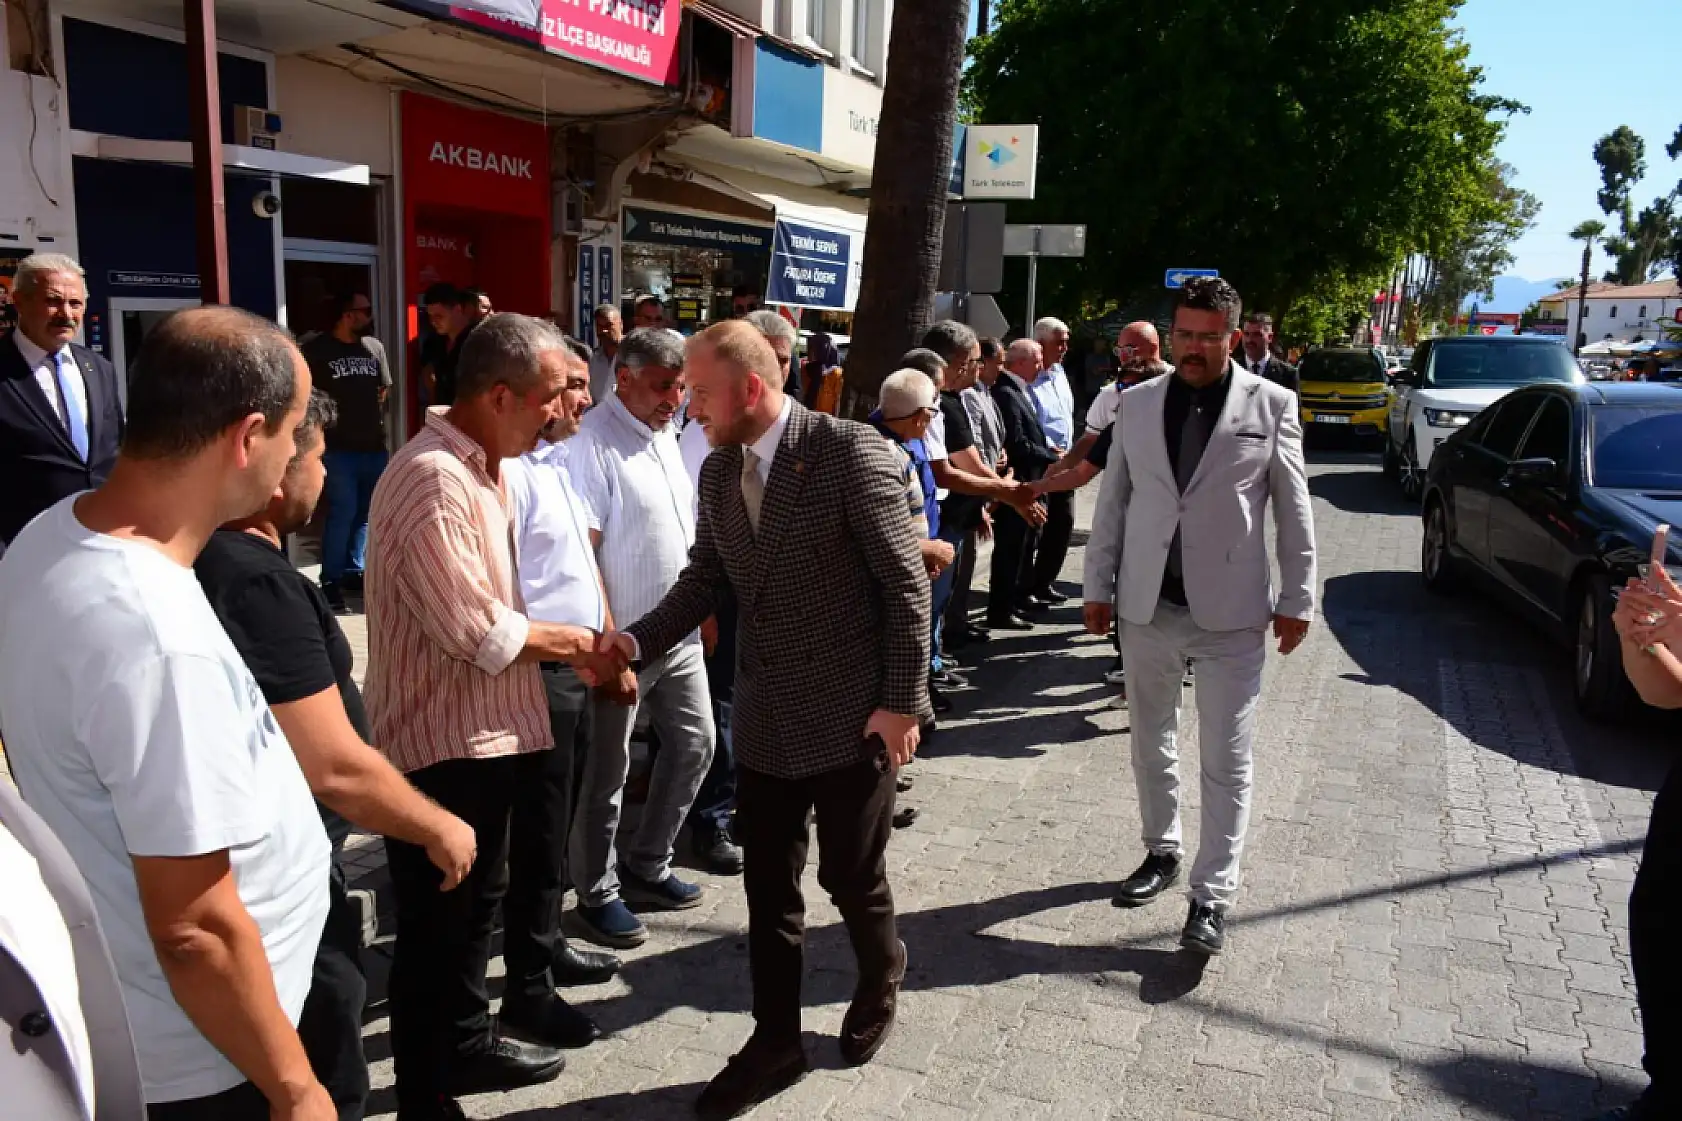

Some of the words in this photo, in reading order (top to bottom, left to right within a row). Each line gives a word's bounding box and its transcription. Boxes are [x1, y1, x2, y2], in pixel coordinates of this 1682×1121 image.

[557, 18, 585, 47] İLÇE
[586, 30, 652, 67] BAŞKANLIĞI
[429, 141, 532, 179] AKBANK
[971, 179, 988, 188] Türk
[991, 179, 1026, 188] Telekom
[815, 239, 838, 255] SERVİS
[582, 252, 591, 346] TEKNİ
